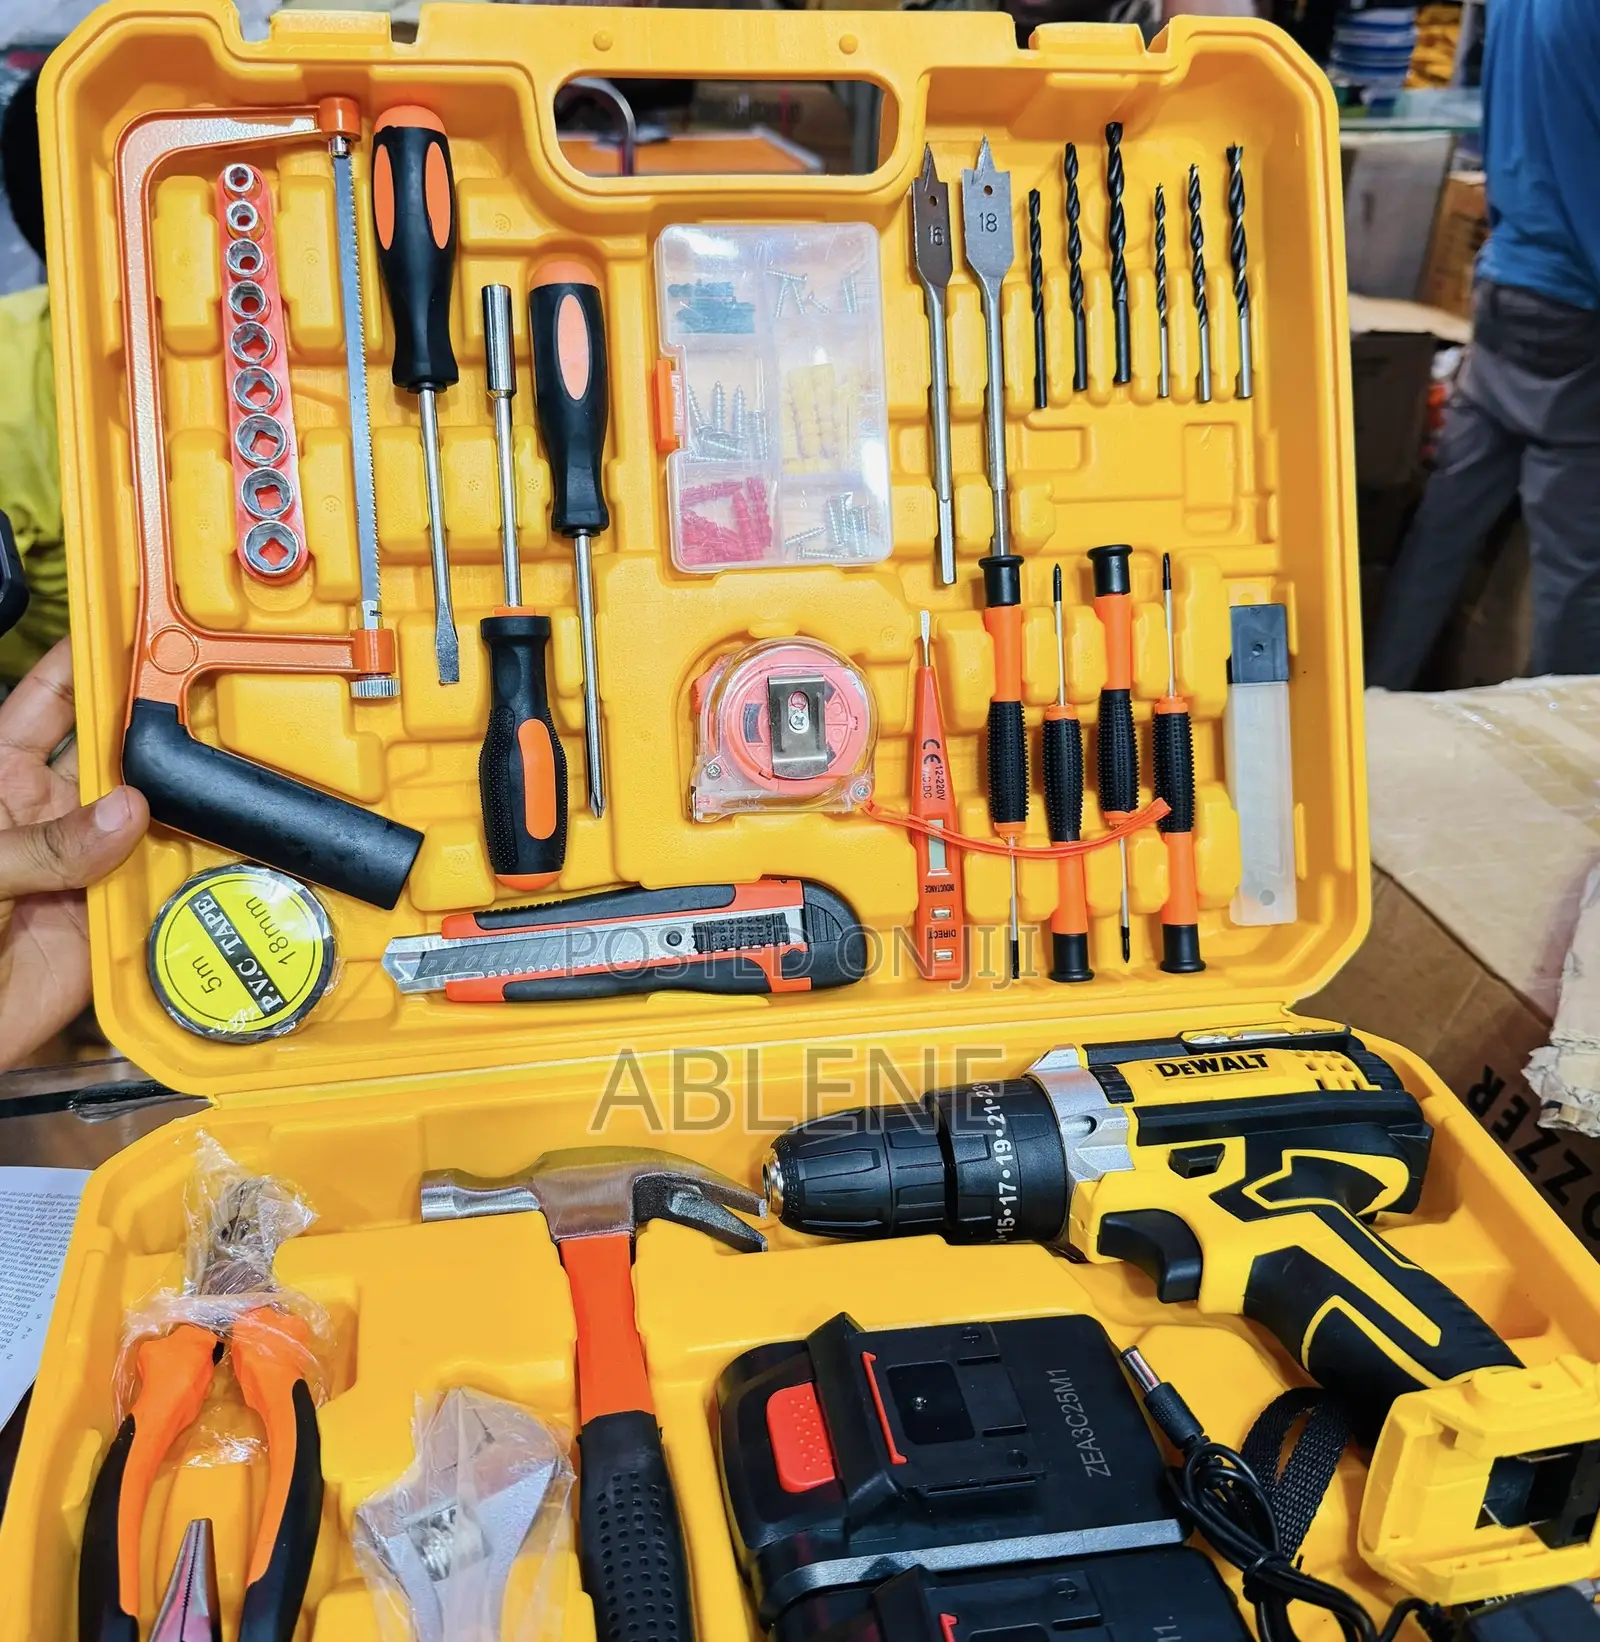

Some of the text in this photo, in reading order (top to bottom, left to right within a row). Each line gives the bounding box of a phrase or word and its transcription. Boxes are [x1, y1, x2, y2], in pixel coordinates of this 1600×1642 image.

[928, 225, 944, 246] 16
[979, 212, 997, 233] 18
[935, 765, 945, 801] 12-220V
[924, 883, 955, 894] INDUCTANCE
[194, 893, 243, 956] TAPE
[245, 895, 296, 965] 18mm
[927, 929, 957, 940] DIRECT
[192, 955, 222, 994] 5m
[1046, 1369, 1112, 1477] ZEA3C25M1
